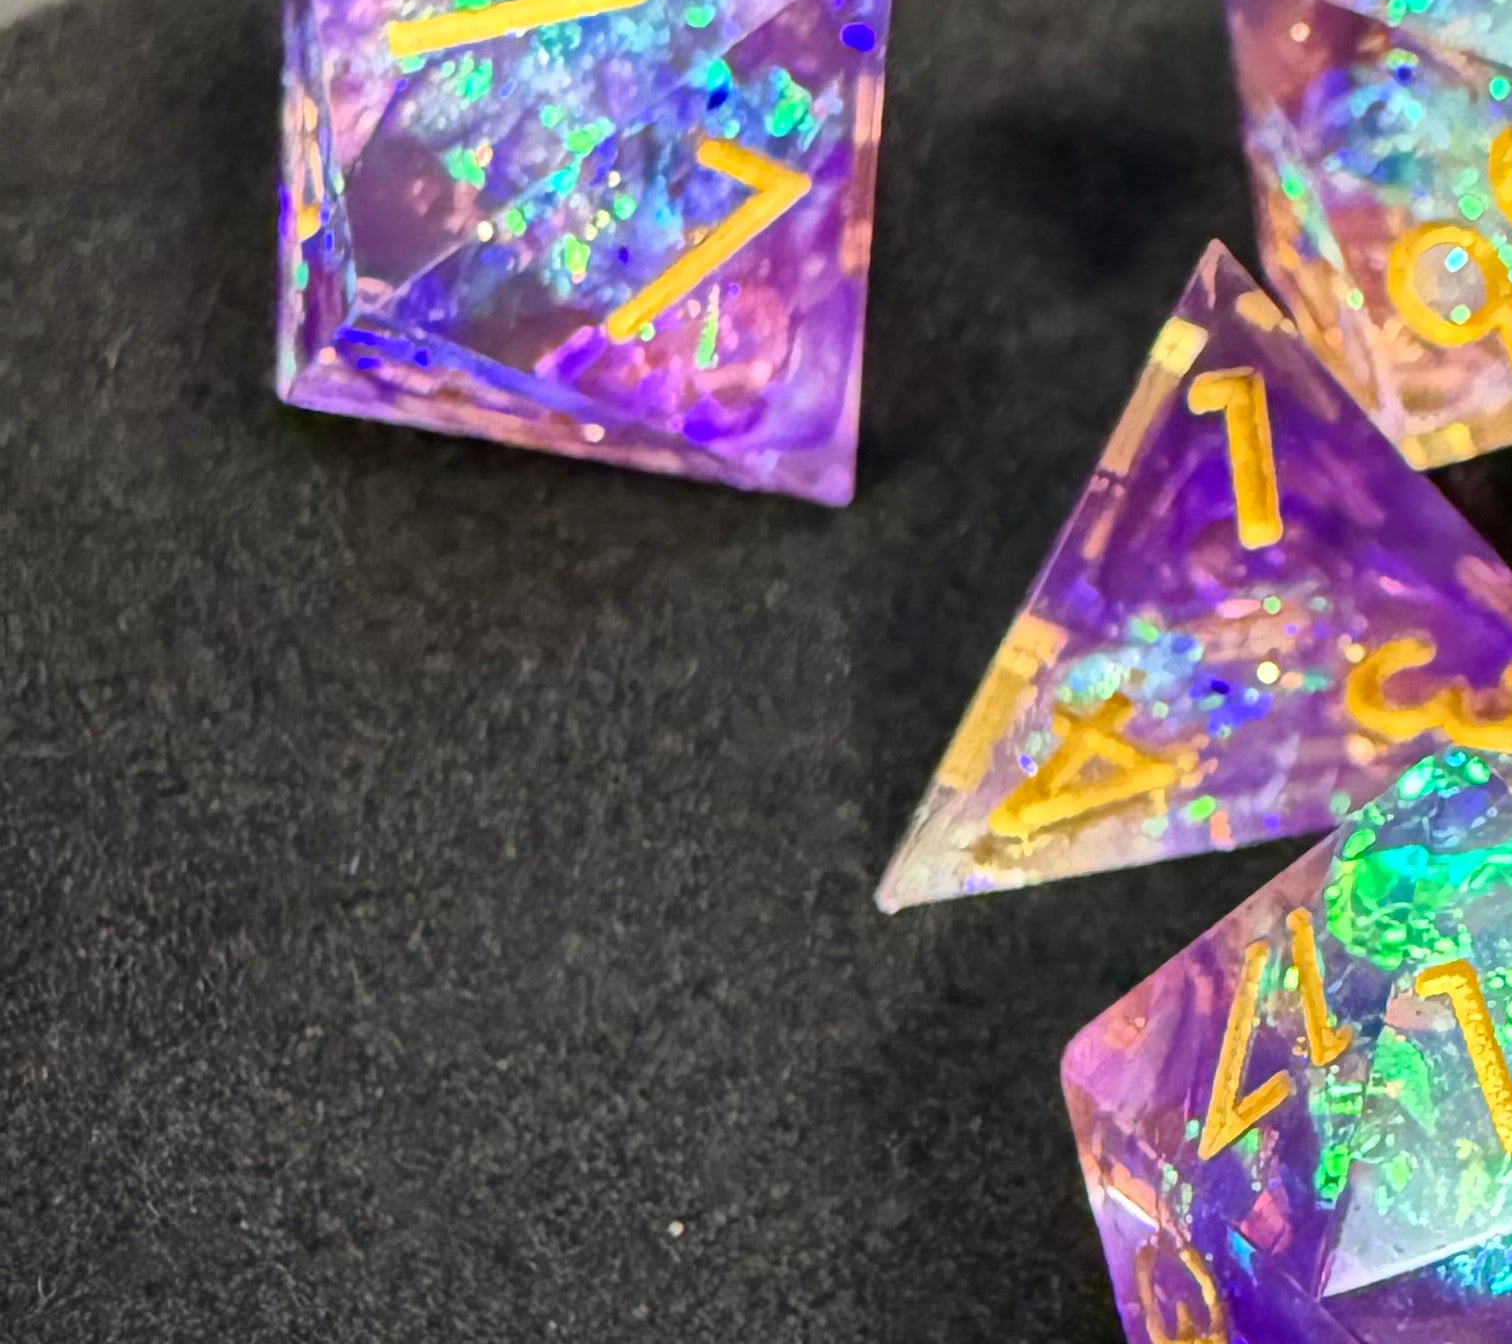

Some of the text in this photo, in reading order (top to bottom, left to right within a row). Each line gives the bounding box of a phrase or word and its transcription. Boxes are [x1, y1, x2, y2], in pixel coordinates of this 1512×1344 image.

[607, 138, 812, 343] 7
[1188, 367, 1284, 550] 1
[987, 691, 1178, 836] 4
[1199, 908, 1352, 1160] 17
